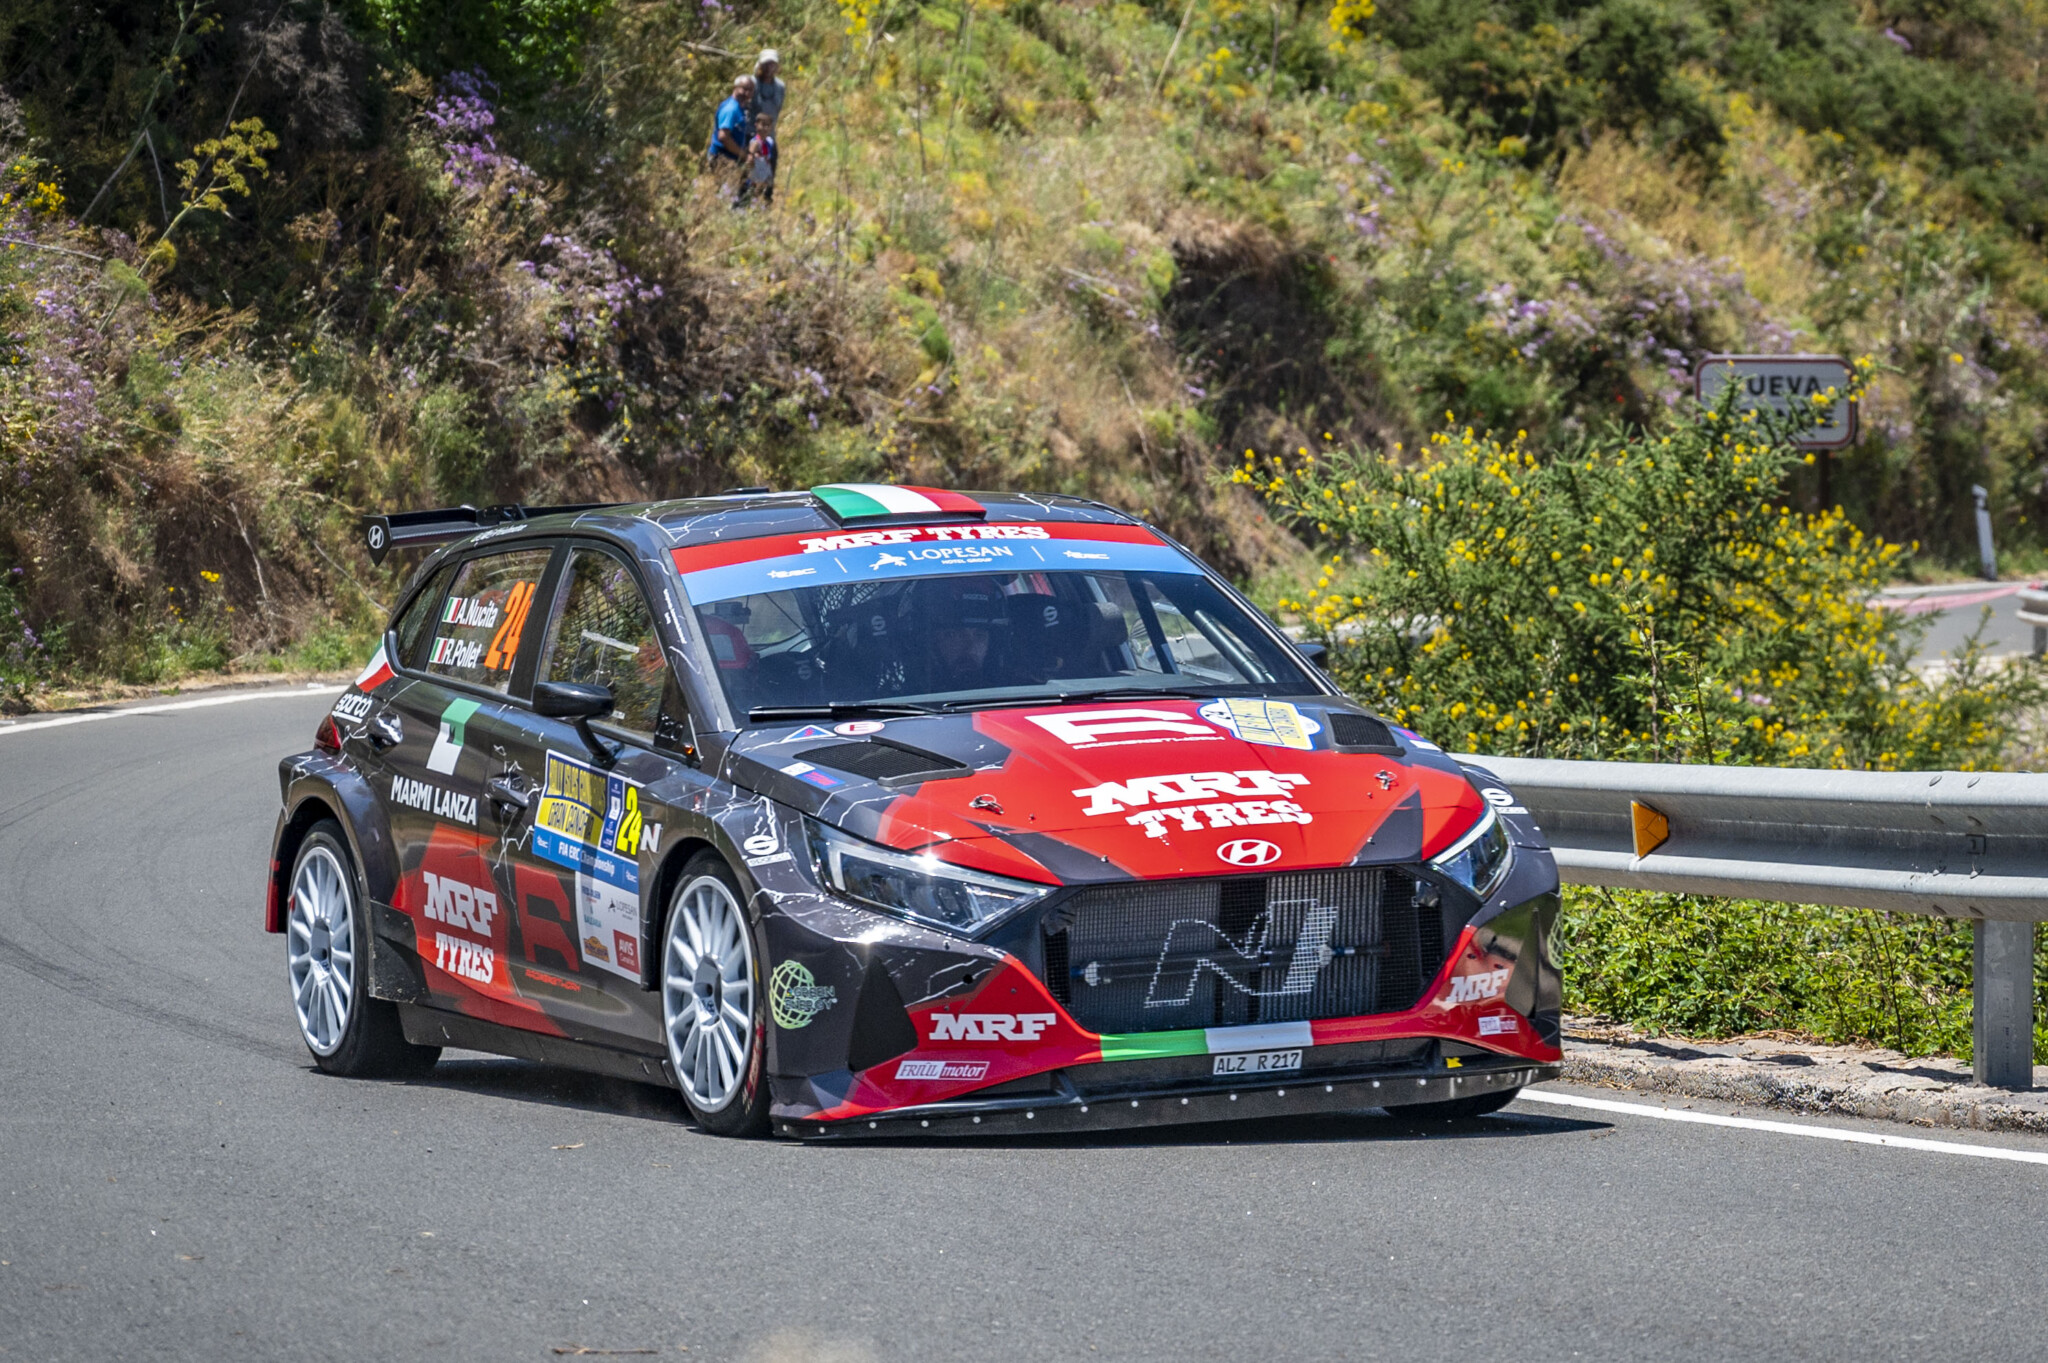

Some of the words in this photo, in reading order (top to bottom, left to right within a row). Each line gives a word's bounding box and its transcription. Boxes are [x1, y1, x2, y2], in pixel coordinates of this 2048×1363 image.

[1730, 375, 1822, 396] UEVA
[799, 528, 921, 554] MRF
[927, 525, 1050, 541] TYRES
[908, 546, 1014, 561] LOPESAN
[455, 598, 498, 628] A.Nucita
[484, 581, 536, 671] 24
[442, 638, 482, 669] R.Pollet
[335, 693, 373, 717] sparco
[391, 774, 432, 811] MARMI
[433, 786, 477, 826] LANZA
[1071, 770, 1311, 817] MRF
[616, 786, 643, 856] 24
[1125, 800, 1314, 839] TYRES
[558, 841, 570, 856] FIA
[568, 845, 580, 861] ERC
[423, 870, 498, 938] MRF
[435, 932, 495, 984] TYRES
[618, 938, 635, 956] AVIS
[793, 985, 836, 997] GREEN
[1445, 968, 1510, 1004] MRF
[929, 1013, 1057, 1041] MRF
[1216, 1056, 1247, 1073] ALZ
[1257, 1055, 1268, 1070] R
[1271, 1052, 1300, 1069] 217
